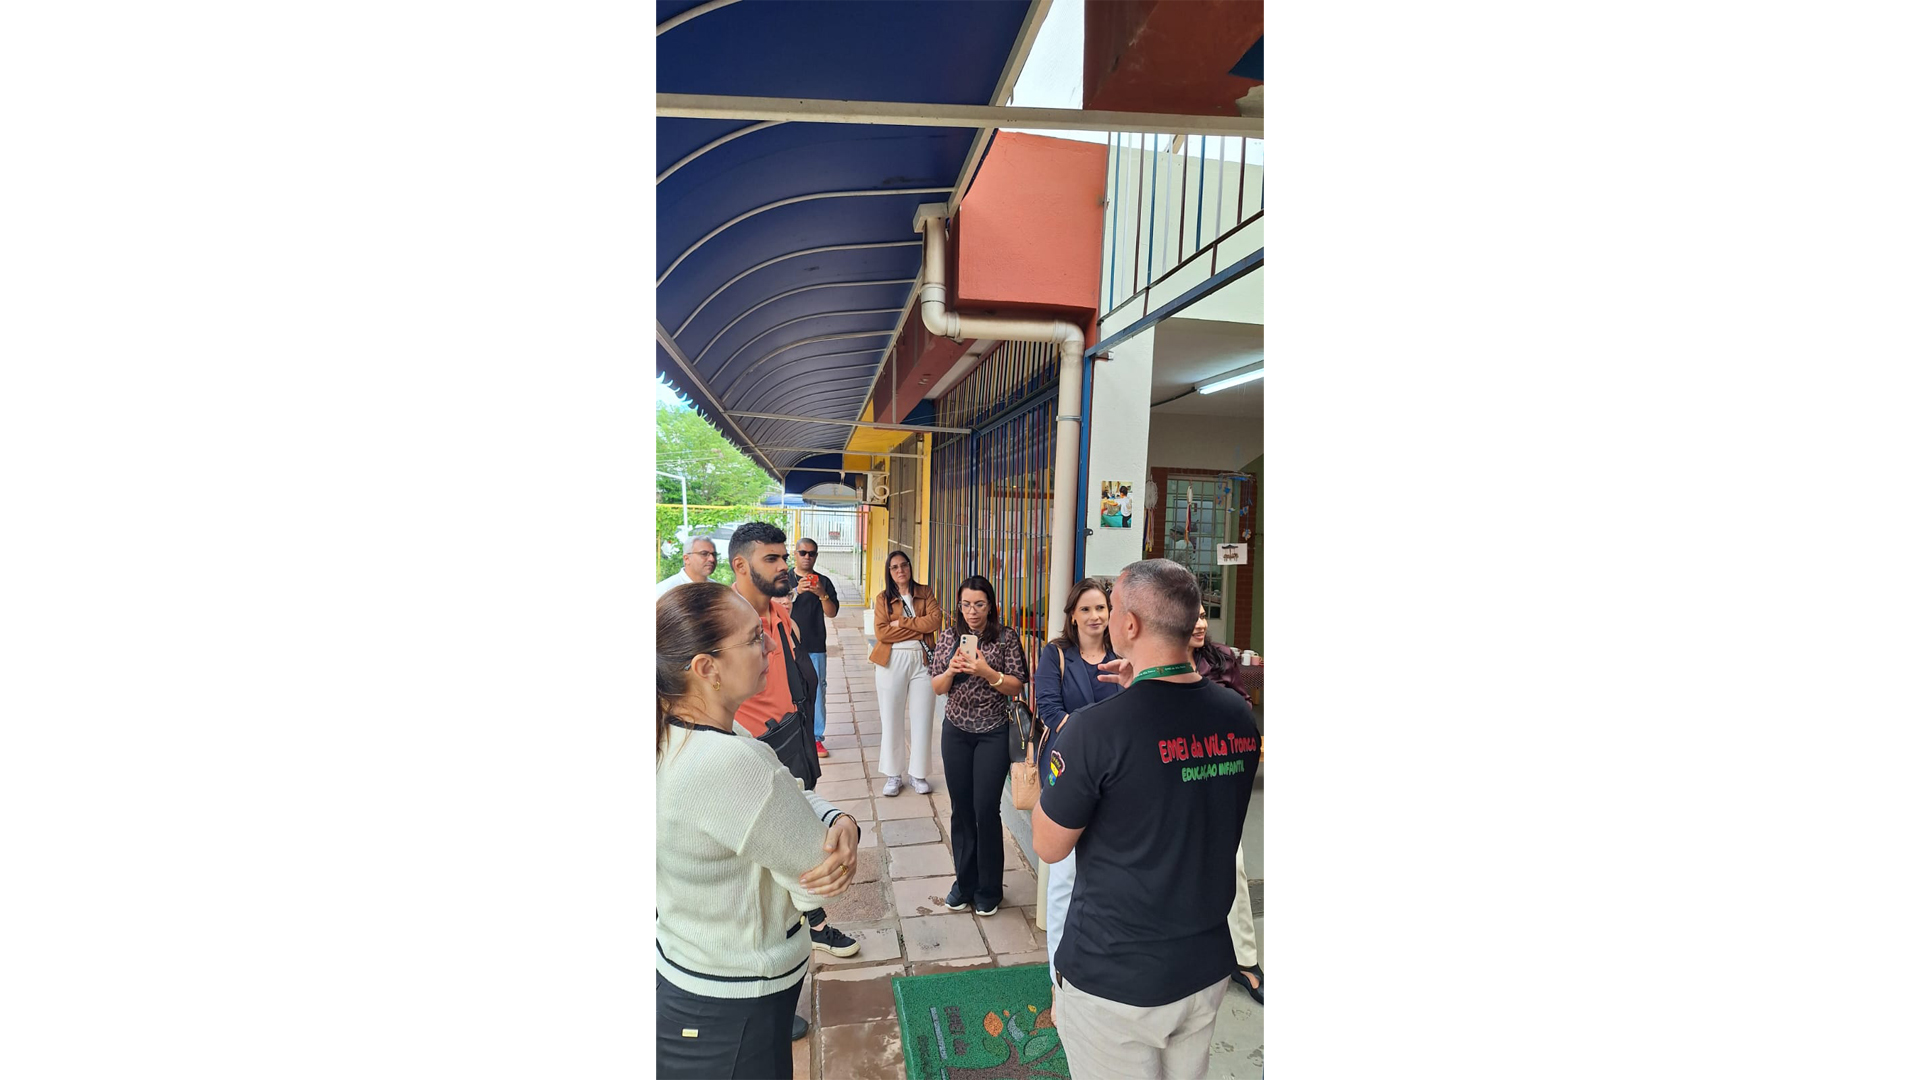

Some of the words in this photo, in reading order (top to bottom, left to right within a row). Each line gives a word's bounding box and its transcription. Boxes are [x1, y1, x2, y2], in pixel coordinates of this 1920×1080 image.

[1159, 737, 1189, 763] EMEI
[1190, 734, 1204, 758] da
[1227, 733, 1257, 754] Tronco
[1218, 760, 1245, 776] INFANTIL
